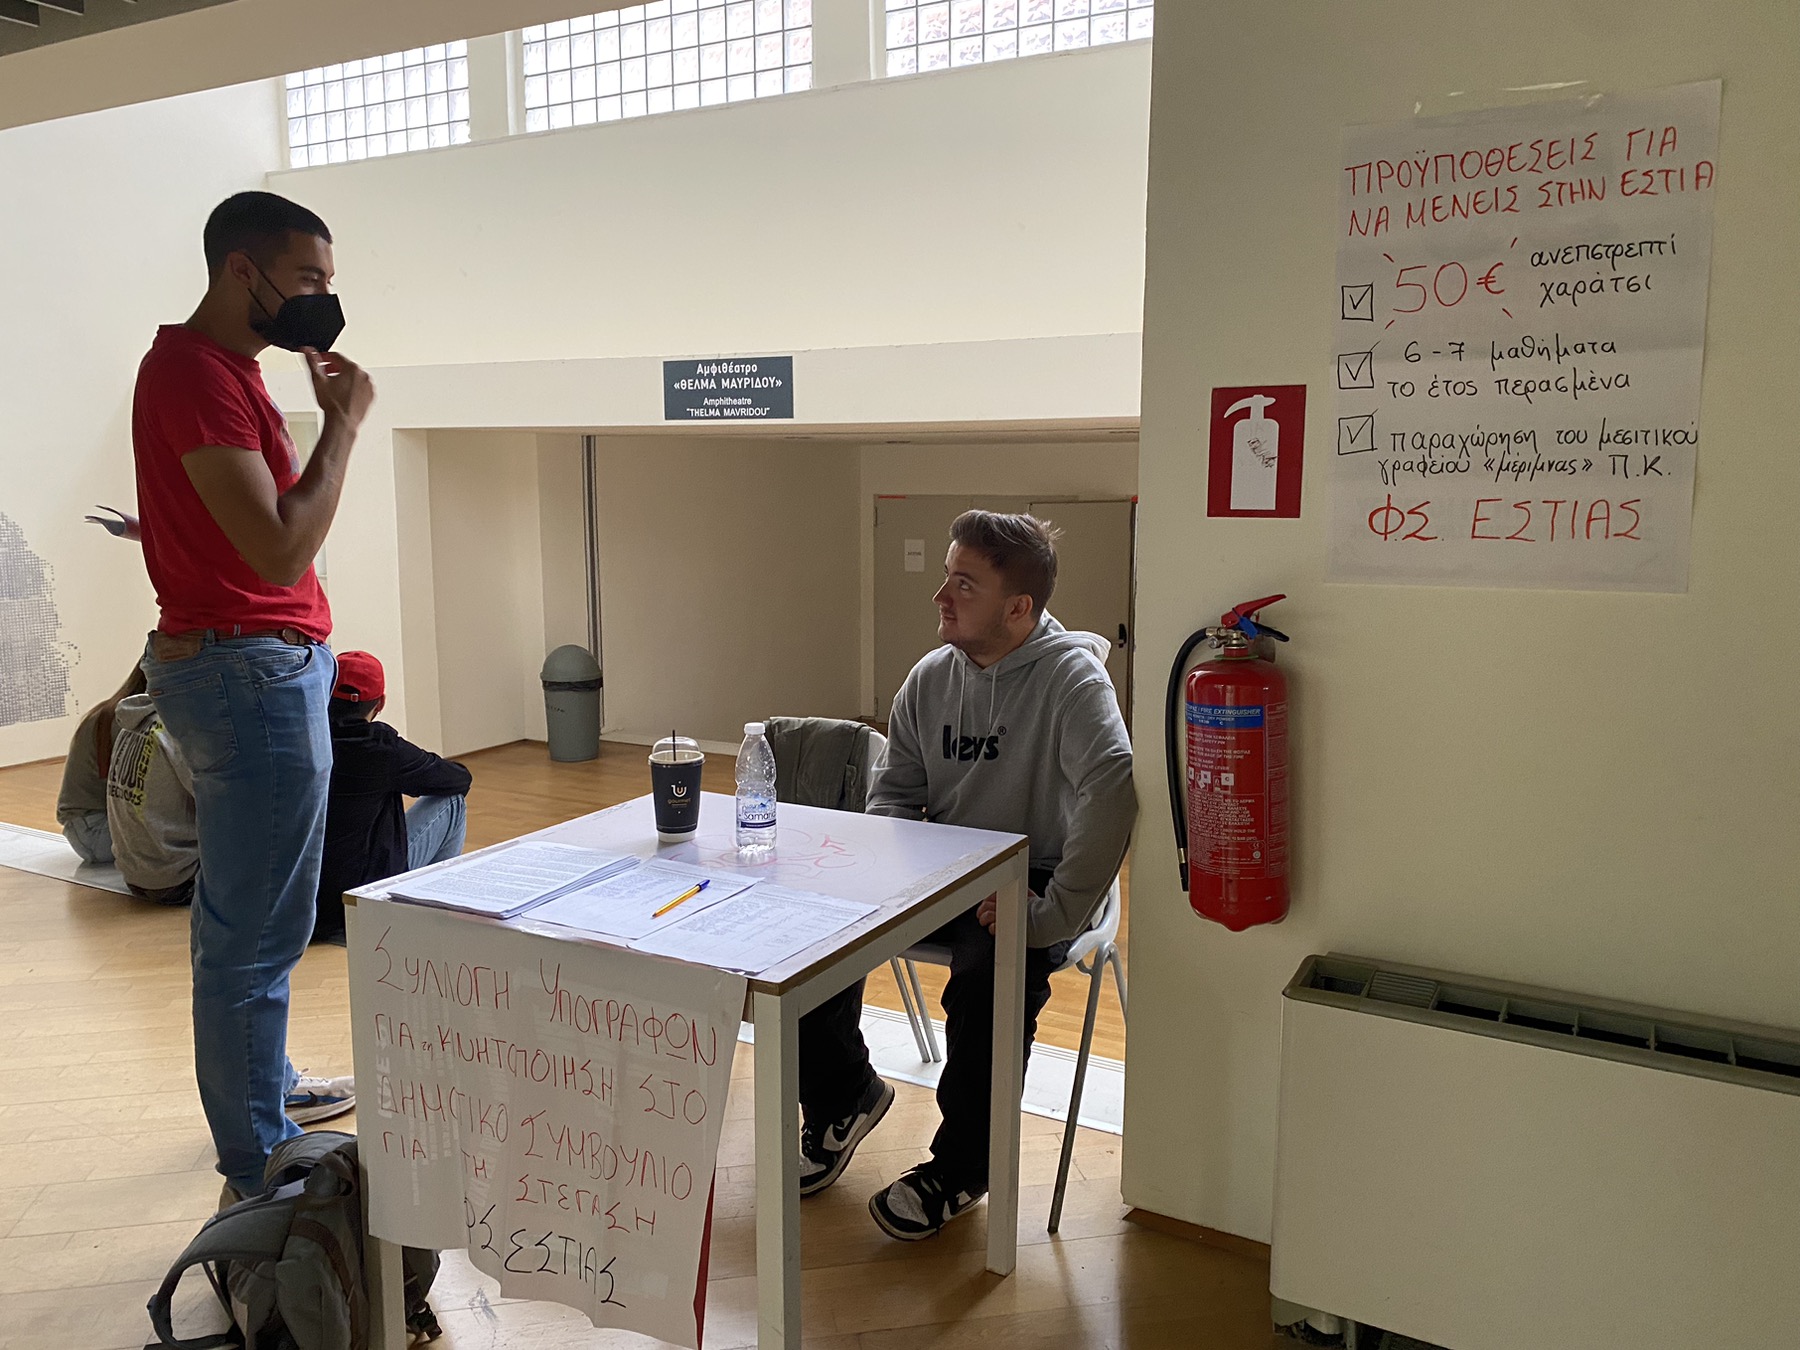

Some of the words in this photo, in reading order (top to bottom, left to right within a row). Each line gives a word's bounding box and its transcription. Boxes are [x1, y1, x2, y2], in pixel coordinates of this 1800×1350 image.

[1345, 132, 1598, 196] ΠΡΟΫΠΟΘΕΣΕΙΣ
[1626, 126, 1677, 161] ΓΙΑ
[1348, 206, 1390, 237] ΝΑ
[1406, 184, 1521, 229] ΜΕΝΕΙΣ
[1537, 176, 1607, 209] ΣΤΗΝ
[1620, 160, 1714, 197] ΕΣΤΙΑ
[1540, 271, 1652, 308] χαράτσι
[696, 362, 758, 376] Αμφιθέατρο
[1490, 332, 1617, 371] μαθήματα
[673, 378, 717, 391] «ΘΕΛΜΑ
[721, 376, 783, 390] ΜΑΥΡΙΔΟΥ»
[703, 397, 752, 407] Amphitheatre
[1387, 380, 1416, 399] το
[1427, 374, 1478, 398] έτος
[1494, 367, 1631, 404] περασμένα
[1390, 424, 1538, 459] παραχώρηση
[1555, 429, 1589, 446] του
[1598, 417, 1699, 452] μεσιτικού
[1378, 453, 1470, 487] γραφείου
[1470, 497, 1642, 542] ΕΣΤΙΑΣ
[1213, 708, 1261, 716] EXTINGUISHER
[374, 925, 510, 1010] ΣΥΛΛΟΓΗ
[375, 1013, 415, 1051] ΓΙΑ
[639, 1073, 707, 1125] ΣΤΟ
[520, 1109, 693, 1201] ΣΥΜΒΟΥΛΙΟ
[382, 1131, 427, 1161] ΓΙΑ
[515, 1173, 656, 1236] ΣΤΕΓΑΣΗ
[503, 1228, 627, 1309] ΕΣΤΙΑΣ
